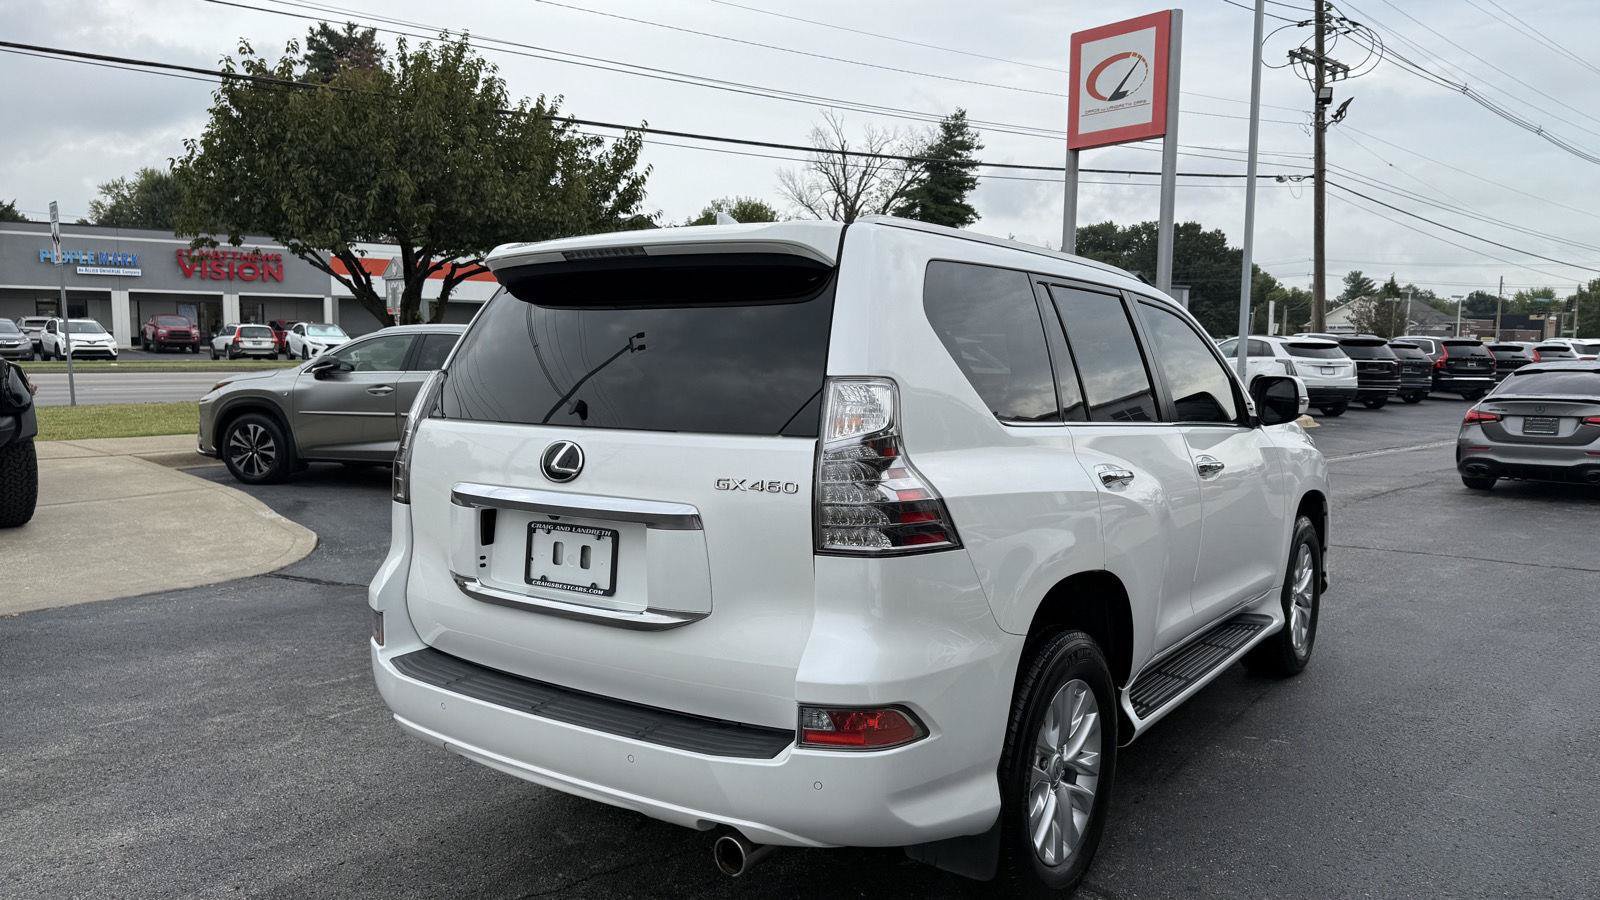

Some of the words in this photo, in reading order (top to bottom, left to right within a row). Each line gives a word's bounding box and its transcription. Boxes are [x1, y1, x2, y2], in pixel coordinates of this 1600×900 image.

[98, 251, 138, 266] MARK
[176, 257, 285, 282] VISION
[531, 522, 554, 531] CRAIG
[555, 525, 571, 533] AND
[572, 527, 612, 537] LANDRETH
[532, 580, 604, 595] CRAIGSBESTCARS.COM
